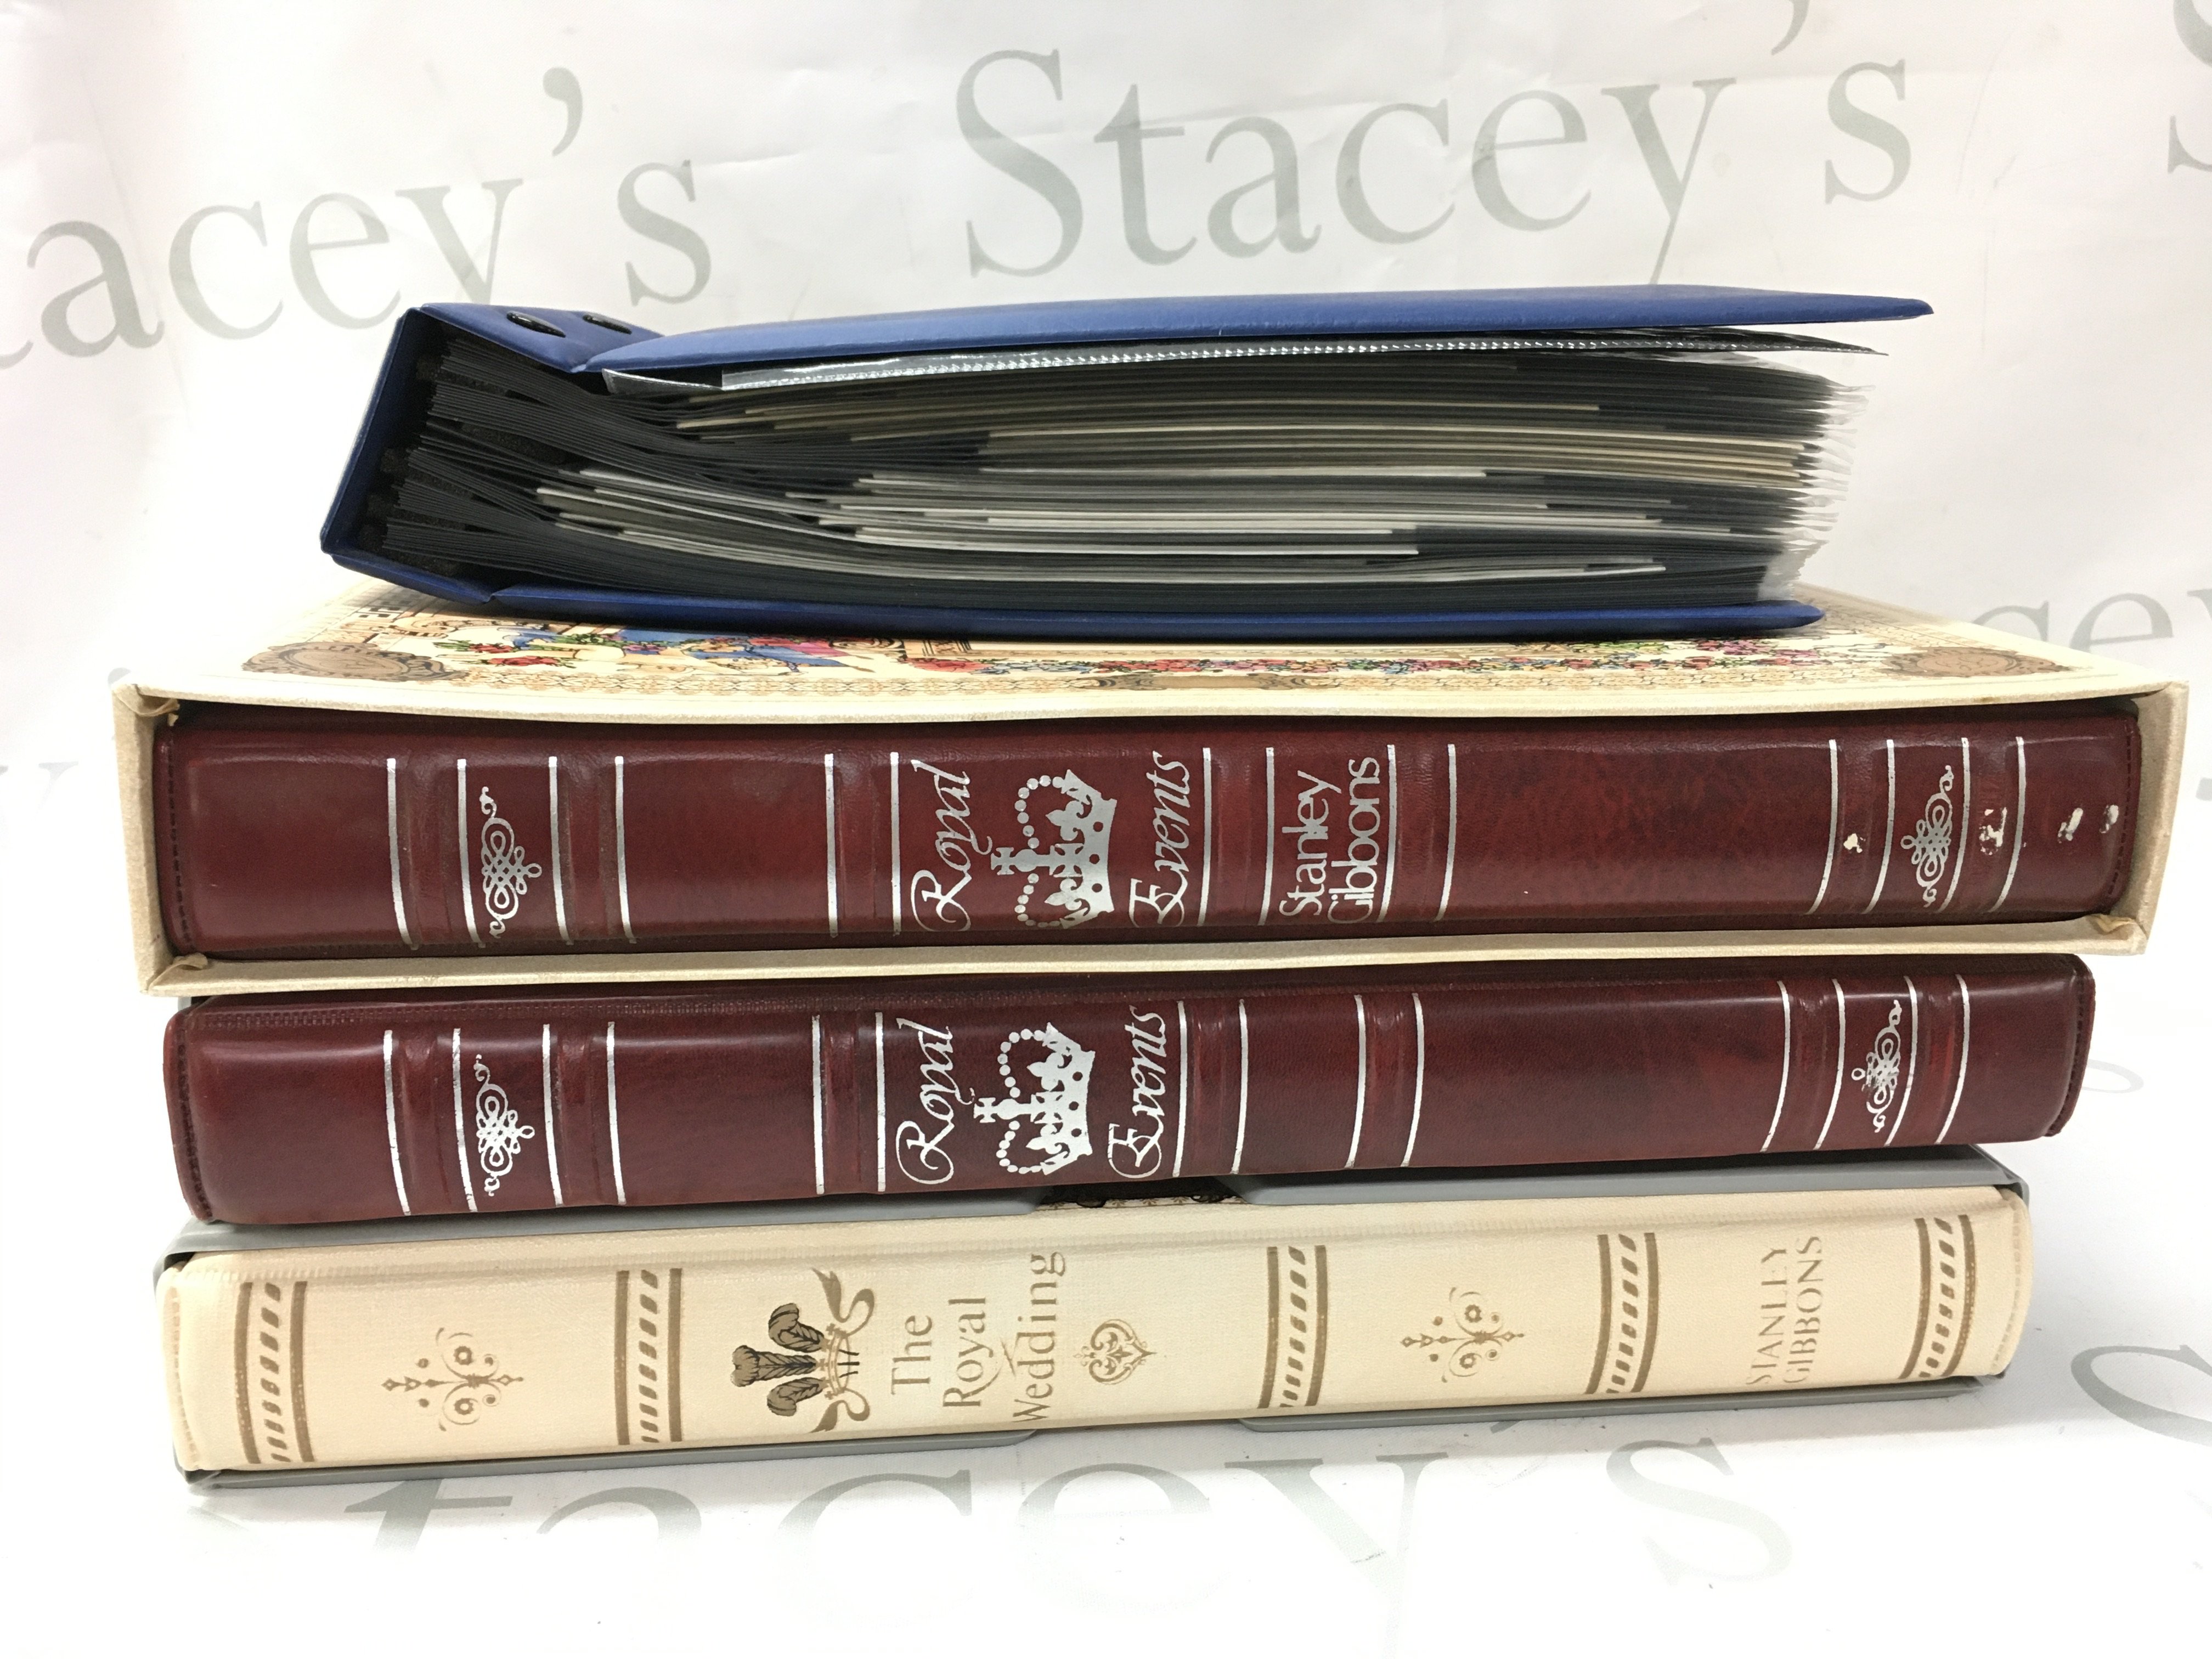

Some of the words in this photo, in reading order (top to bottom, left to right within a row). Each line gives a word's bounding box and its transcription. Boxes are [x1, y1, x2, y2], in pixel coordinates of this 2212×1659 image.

[0, 66, 712, 369] acey's
[911, 759, 992, 932] Royal
[1129, 751, 1191, 927] Events
[1279, 770, 1341, 915] Stanley
[1328, 757, 1380, 924] Gibbons
[895, 1017, 975, 1185] Royal
[1107, 1005, 1167, 1178] Events
[890, 1313, 933, 1395] The
[942, 1297, 1004, 1408] Royal
[1011, 1251, 1066, 1423] Wedding
[1782, 1235, 1824, 1384] GIBBONS
